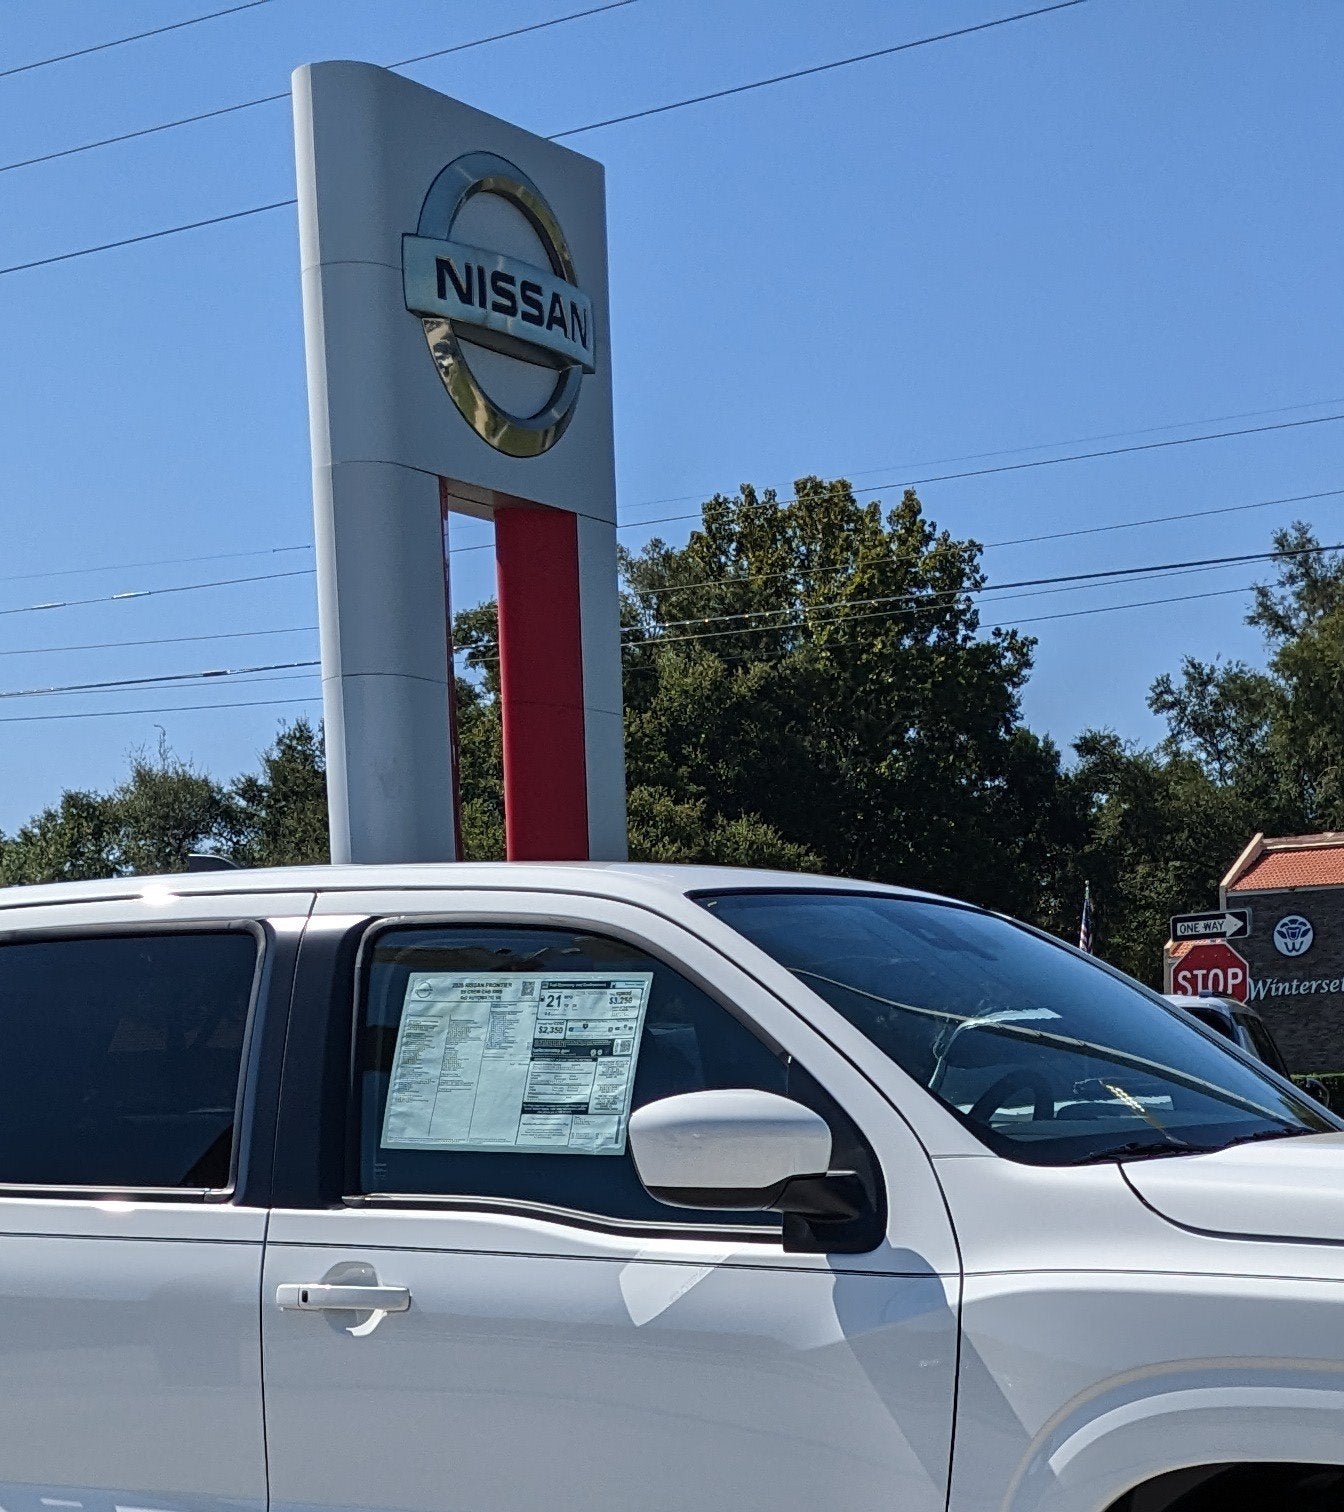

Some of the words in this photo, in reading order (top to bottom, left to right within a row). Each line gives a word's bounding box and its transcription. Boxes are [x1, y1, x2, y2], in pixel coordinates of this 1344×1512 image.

[434, 255, 588, 350] NISSAN
[1179, 922, 1200, 934] ONE
[1203, 920, 1225, 932] WAY
[1177, 967, 1243, 997] STOP
[545, 994, 562, 1008] 21
